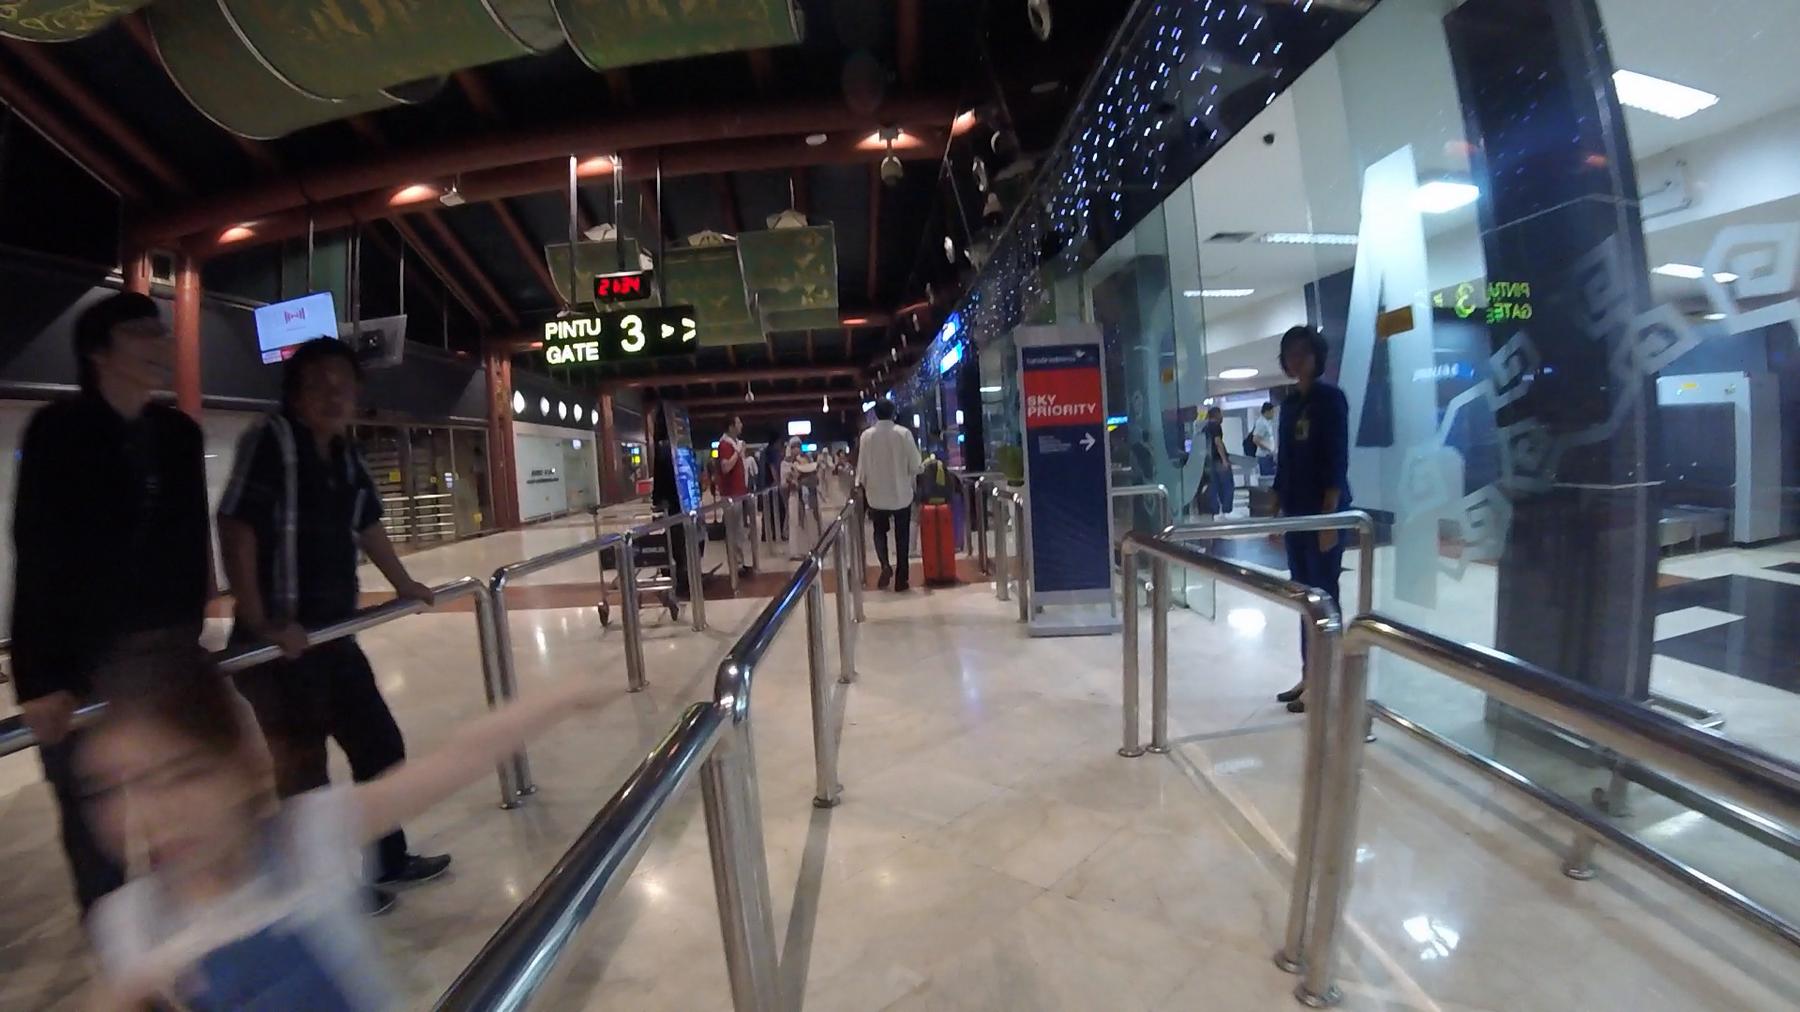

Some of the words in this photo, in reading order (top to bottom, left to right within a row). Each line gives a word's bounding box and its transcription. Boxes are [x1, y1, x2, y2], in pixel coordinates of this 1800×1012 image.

[545, 318, 602, 341] PINTU
[620, 314, 646, 352] 3
[545, 341, 600, 364] GATE
[1027, 394, 1057, 407] SKY
[1027, 402, 1097, 418] PRIORITY
